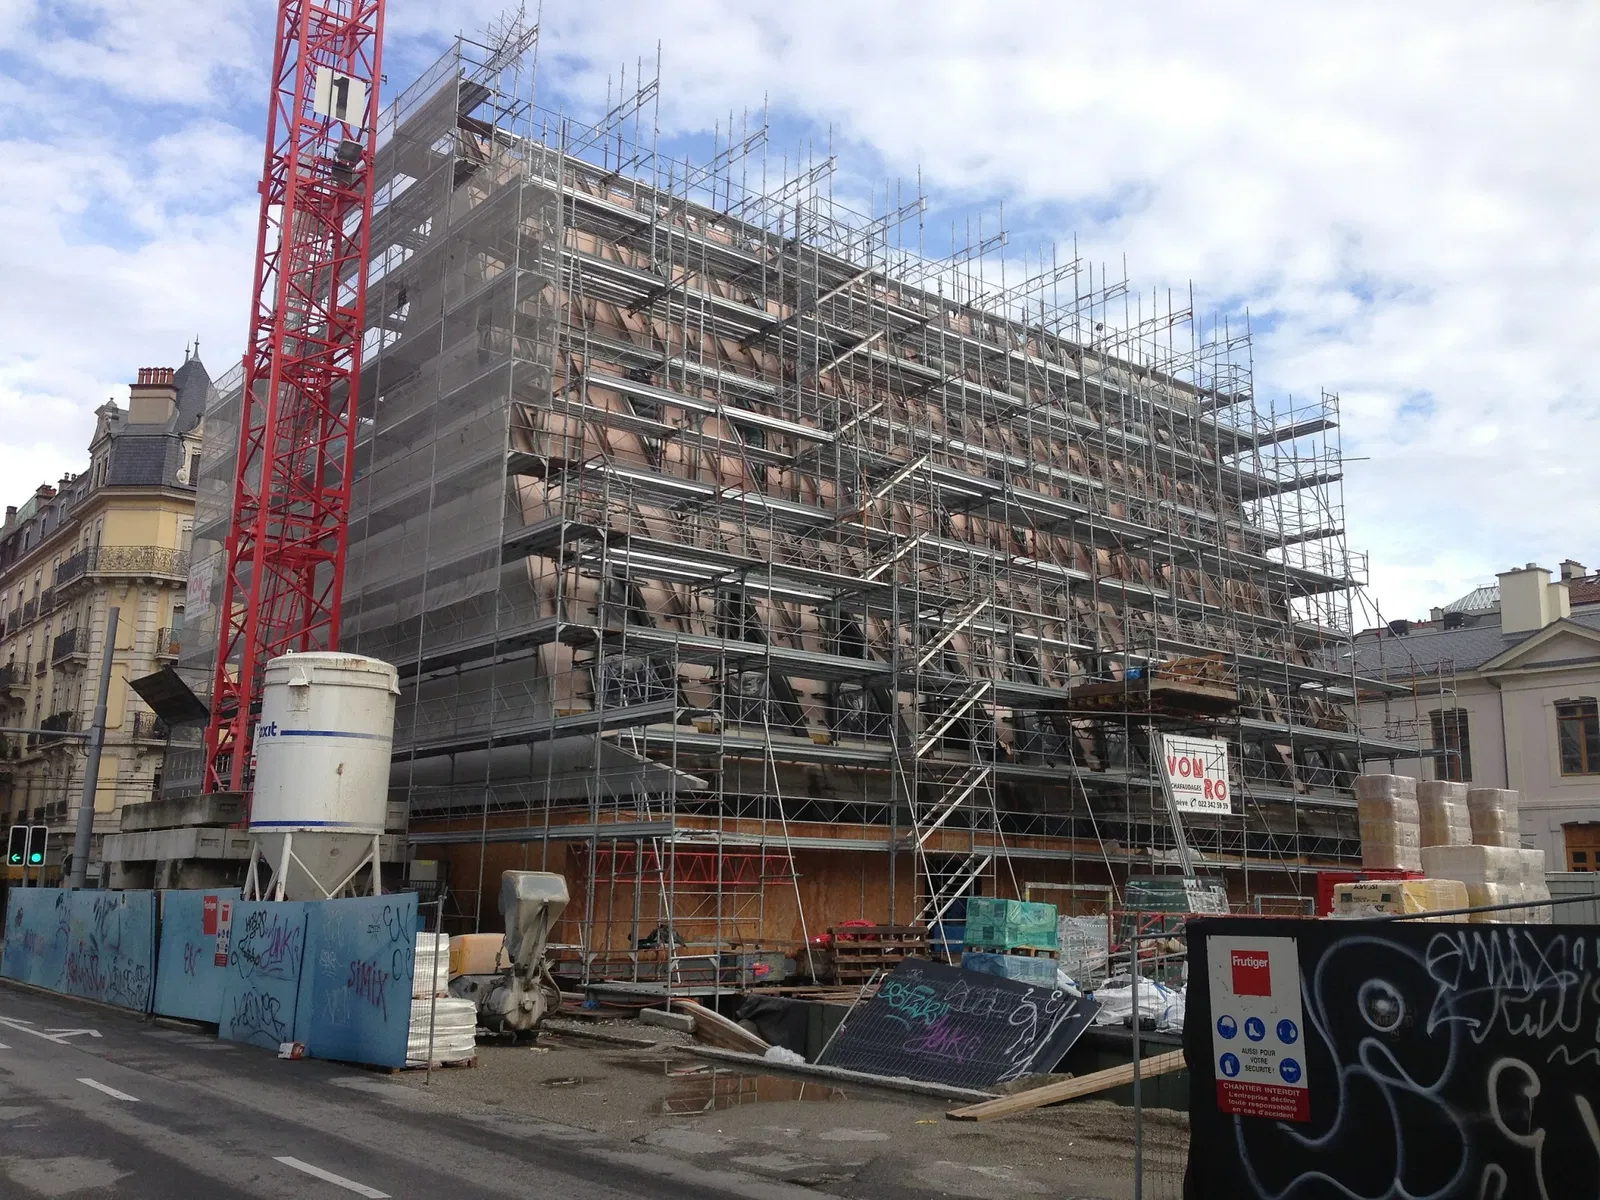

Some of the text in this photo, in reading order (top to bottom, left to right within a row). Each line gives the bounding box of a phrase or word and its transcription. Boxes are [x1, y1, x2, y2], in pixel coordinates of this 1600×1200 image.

[333, 76, 350, 121] 1
[1167, 755, 1203, 778] VON
[1171, 783, 1202, 791] CHAFAUDAGES
[1204, 778, 1227, 801] RO
[1198, 800, 1207, 808] 022
[1207, 801, 1216, 809] 342
[1232, 955, 1268, 970] Frutiger
[1241, 1047, 1276, 1057] AUSSI POUR
[1250, 1057, 1268, 1065] VOTRE
[1223, 1082, 1300, 1097] CHANTIER INTERDIT
[1228, 1091, 1296, 1104] L'entreprise décline
[1228, 1099, 1297, 1112] toute responsabilité
